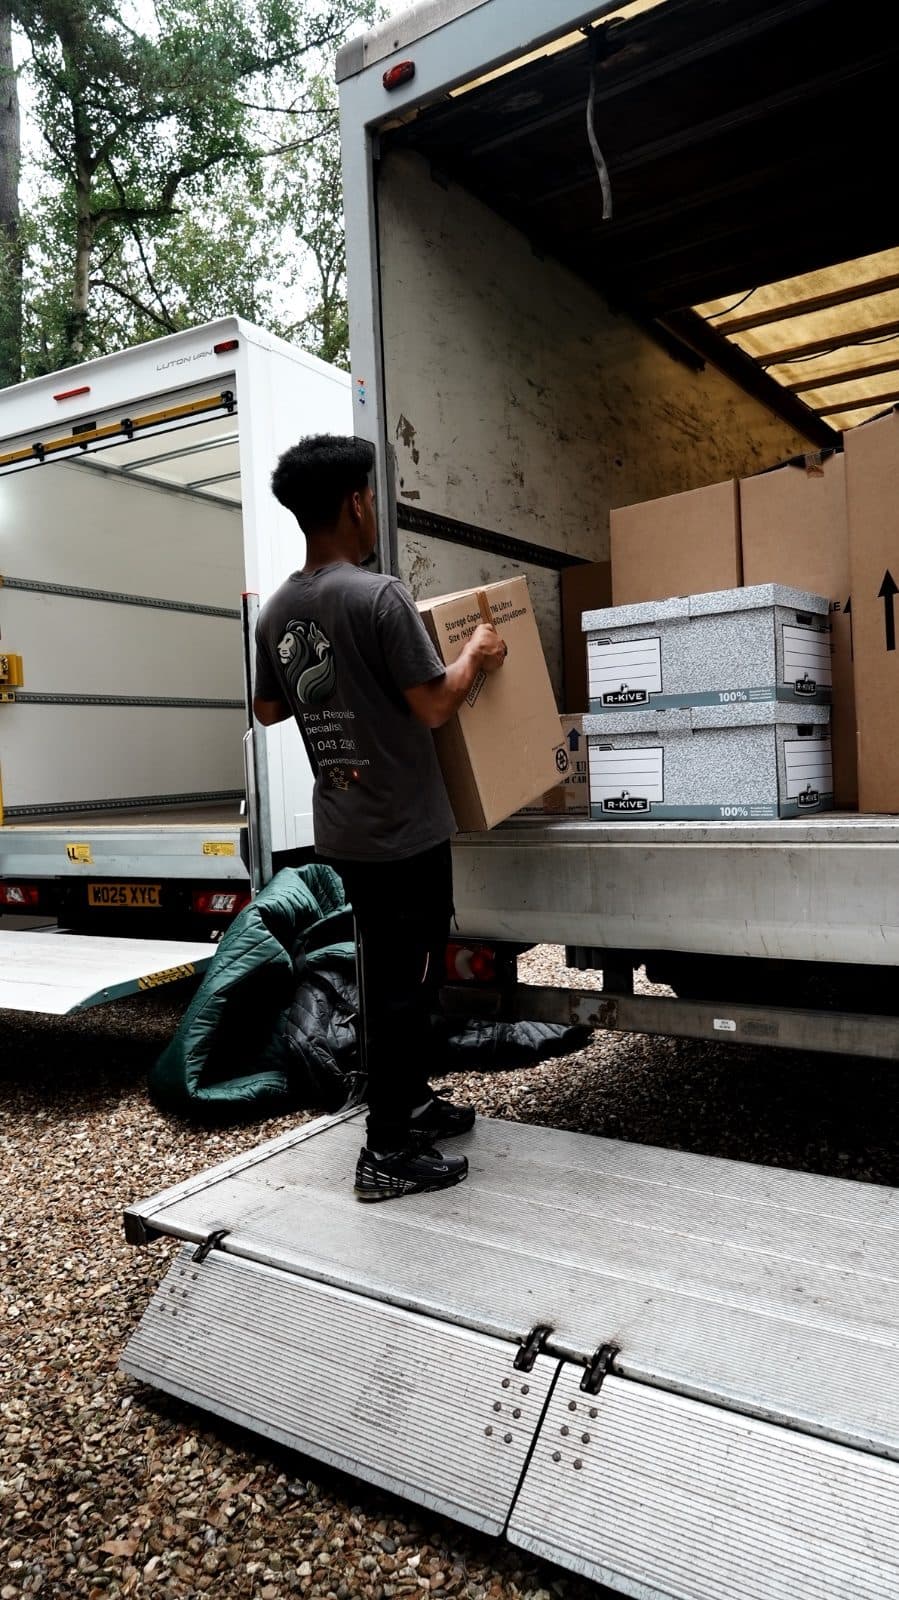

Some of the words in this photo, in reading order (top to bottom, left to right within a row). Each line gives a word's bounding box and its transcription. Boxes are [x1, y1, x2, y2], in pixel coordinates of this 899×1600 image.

[156, 356, 192, 371] LUTON
[445, 616, 467, 631] Storage
[448, 633, 461, 644] Size
[606, 692, 644, 703] R-KIVE
[719, 690, 748, 703] 100%
[303, 712, 321, 722] Fox
[607, 800, 646, 809] R-KIVE
[720, 806, 749, 817] 100%
[130, 887, 157, 904] XYC
